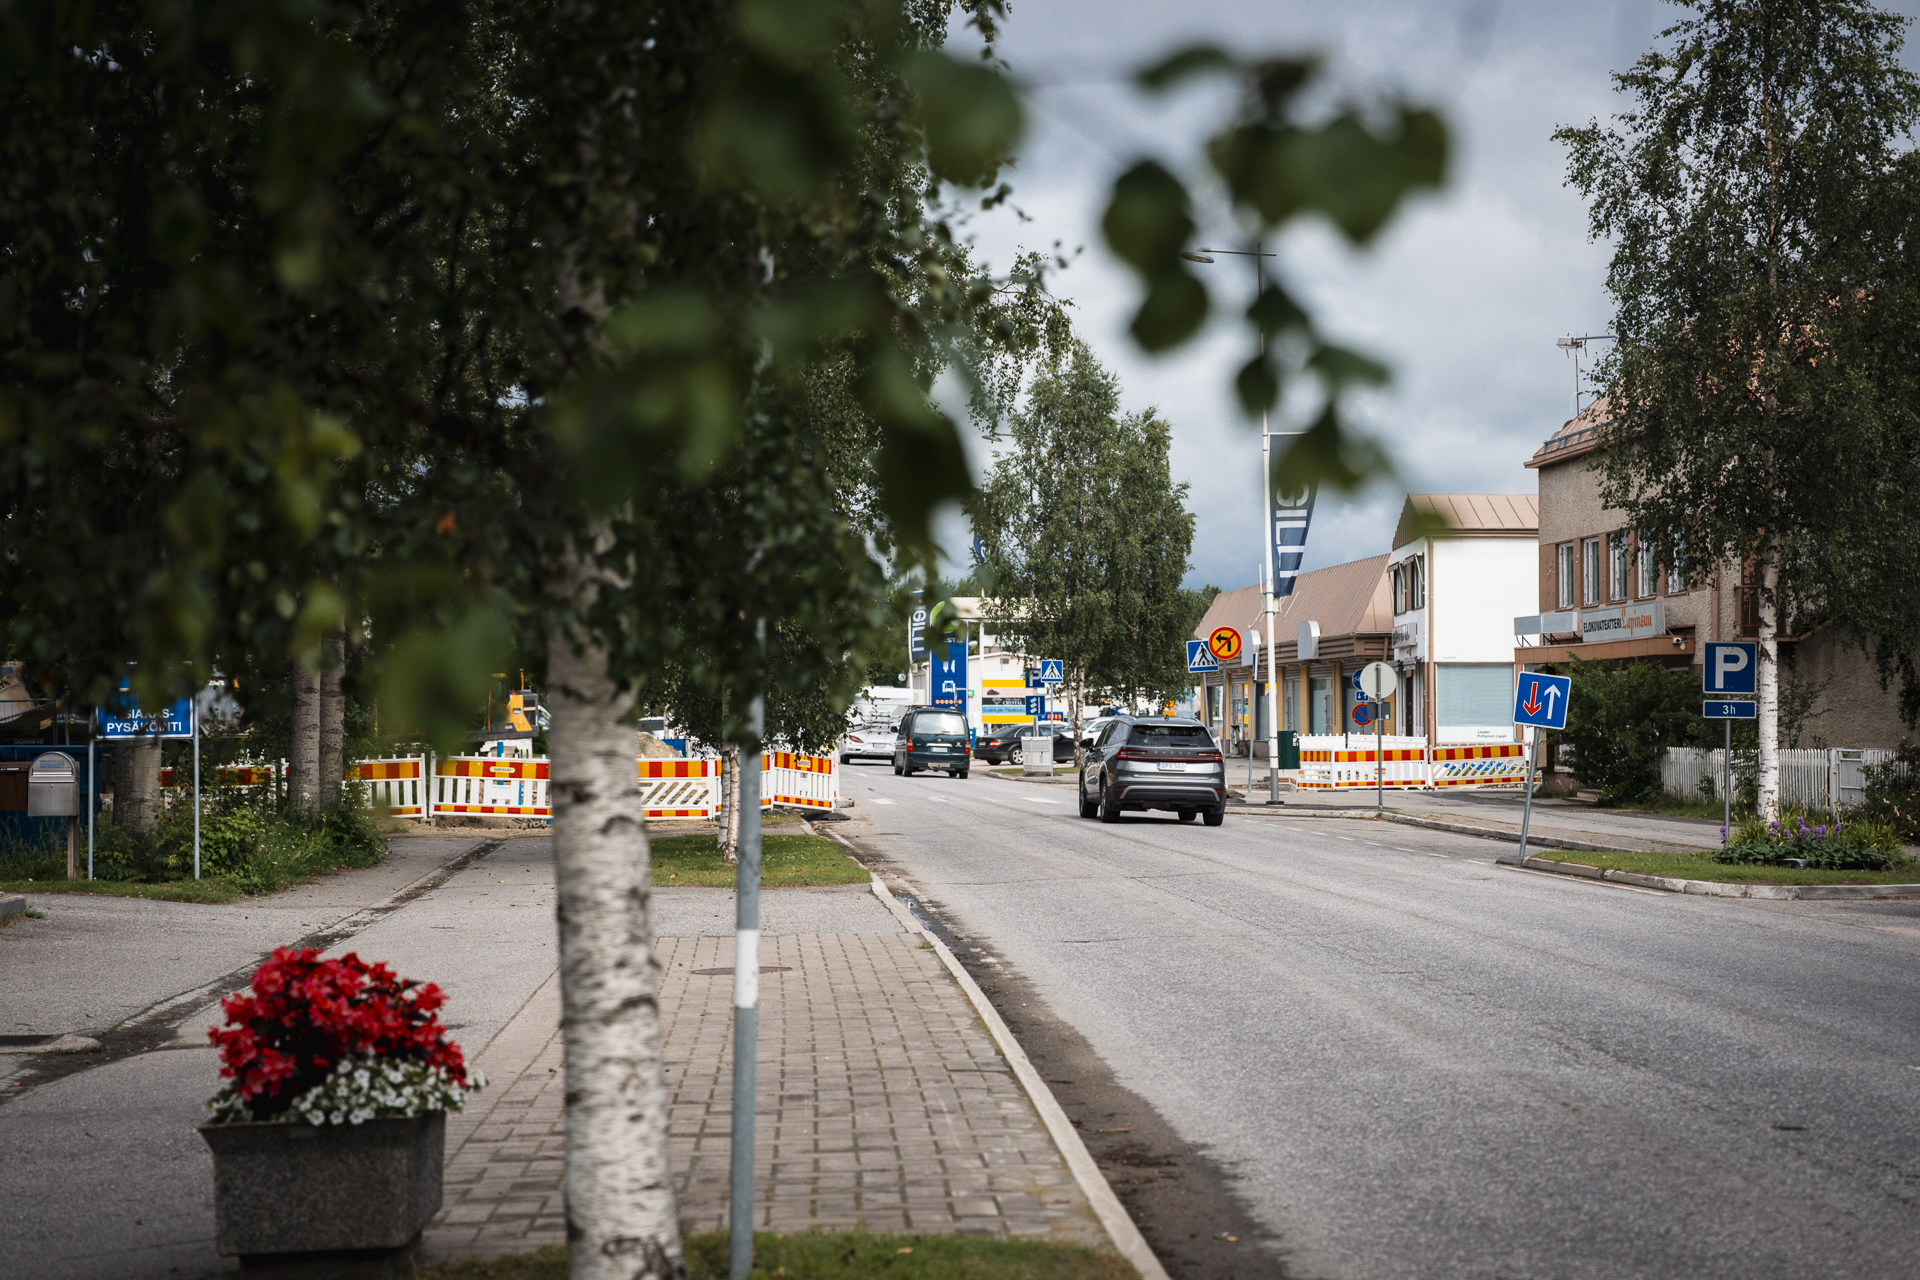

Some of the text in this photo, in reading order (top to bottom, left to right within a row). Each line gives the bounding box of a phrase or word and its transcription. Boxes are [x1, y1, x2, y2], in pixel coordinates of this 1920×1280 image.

[1583, 607, 1652, 636] ELOKUVATEATTERI Lapinsuu
[1715, 646, 1748, 689] P
[1029, 670, 1040, 686] P
[113, 708, 175, 720] SIAKAS-
[106, 720, 182, 733] PYSÄKÖINTI
